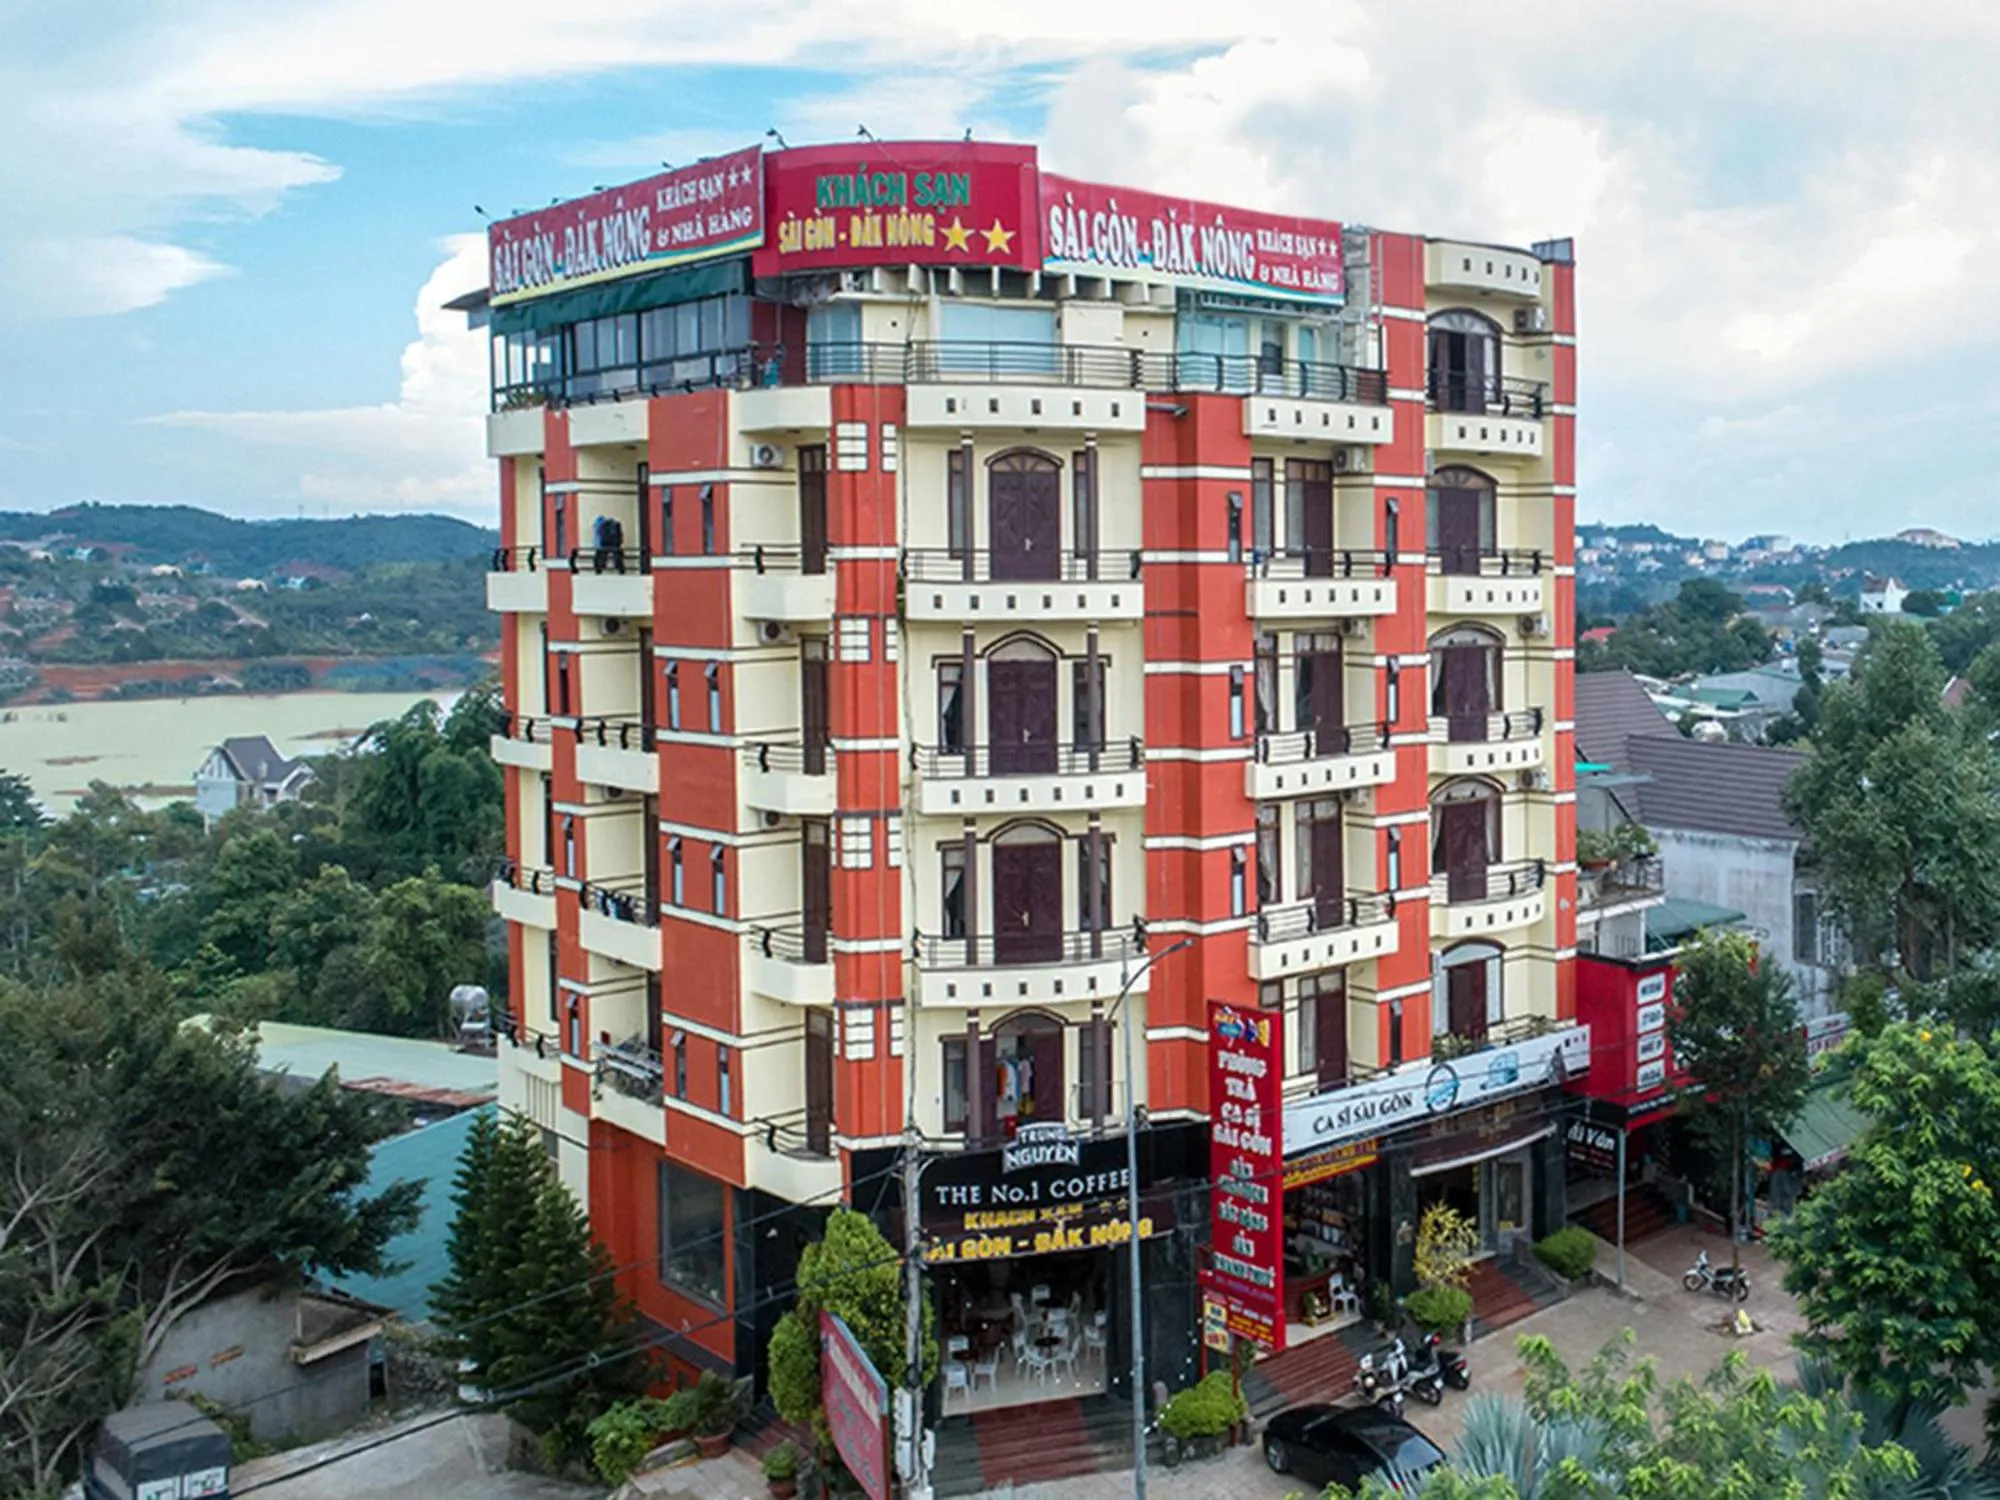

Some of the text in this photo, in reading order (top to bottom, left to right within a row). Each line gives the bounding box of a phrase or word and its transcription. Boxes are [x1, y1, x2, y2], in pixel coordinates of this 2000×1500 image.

[656, 178, 697, 213] KHÁCH
[816, 162, 971, 214] KHÁCH SẠN
[494, 228, 519, 294] SÀI
[522, 220, 555, 287] GÒN
[601, 195, 652, 271] NÔNG
[672, 213, 704, 245] NHÀ
[708, 205, 753, 236] HÀNG
[778, 210, 802, 255] SÀI
[804, 207, 836, 251] GÒN
[886, 204, 935, 248] NÔNG
[1050, 191, 1088, 262] SÀI
[1092, 197, 1138, 268] GÒN
[1200, 213, 1256, 282] NÔNG
[1312, 1115, 1335, 1135] CA
[935, 1168, 1131, 1205] THE No.1 COFFEE
